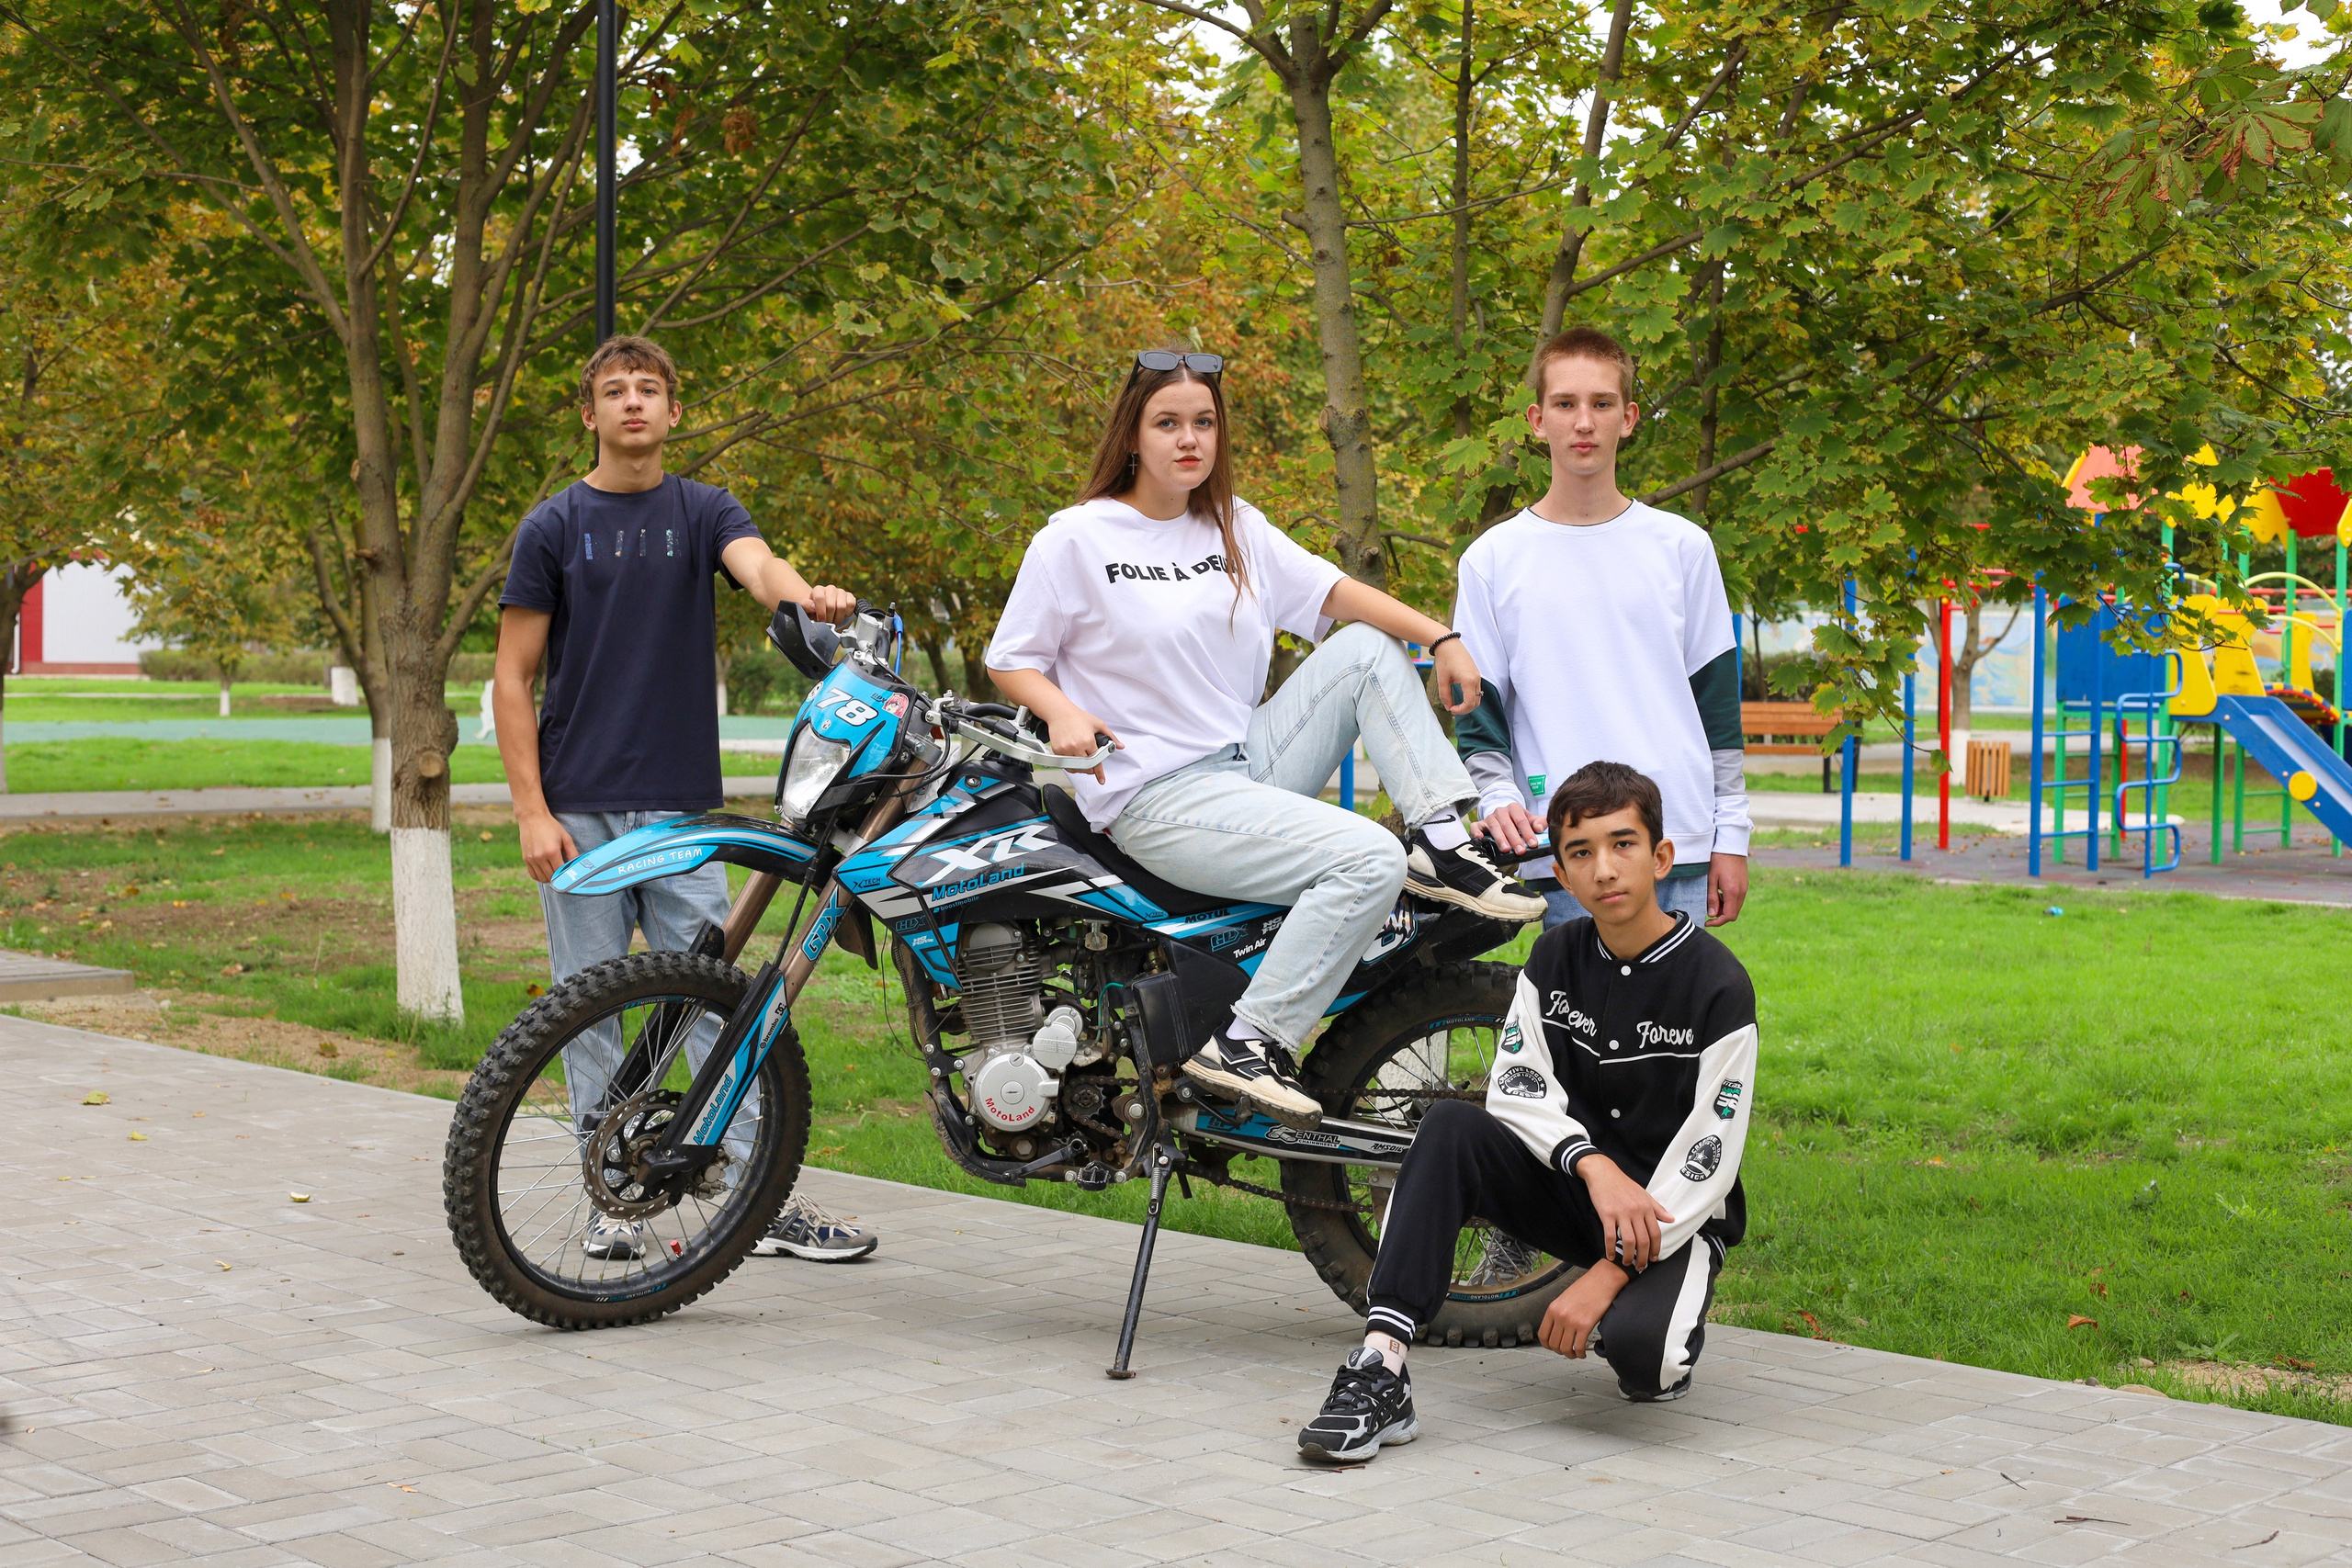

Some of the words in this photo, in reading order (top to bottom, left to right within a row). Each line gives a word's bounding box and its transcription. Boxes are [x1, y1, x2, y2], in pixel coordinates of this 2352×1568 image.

[1105, 563, 1170, 583] FOLIE
[1171, 562, 1192, 581] À
[1191, 555, 1238, 574] DEU
[815, 687, 878, 727] 78
[617, 855, 664, 874] RACING
[670, 848, 702, 860] TEAM
[932, 862, 1025, 901] MotoLand
[802, 884, 845, 961] GPX
[1185, 908, 1230, 924] MOTUL
[1233, 944, 1253, 959] Twin
[1254, 938, 1267, 950] Air
[1545, 990, 1597, 1037] Foever
[763, 1018, 779, 1043] brembo
[693, 1073, 734, 1145] MotoLand
[985, 1098, 1035, 1122] MotoLand
[1370, 1143, 1404, 1153] AMSOIL
[1680, 1168, 1704, 1180] ESIGN
